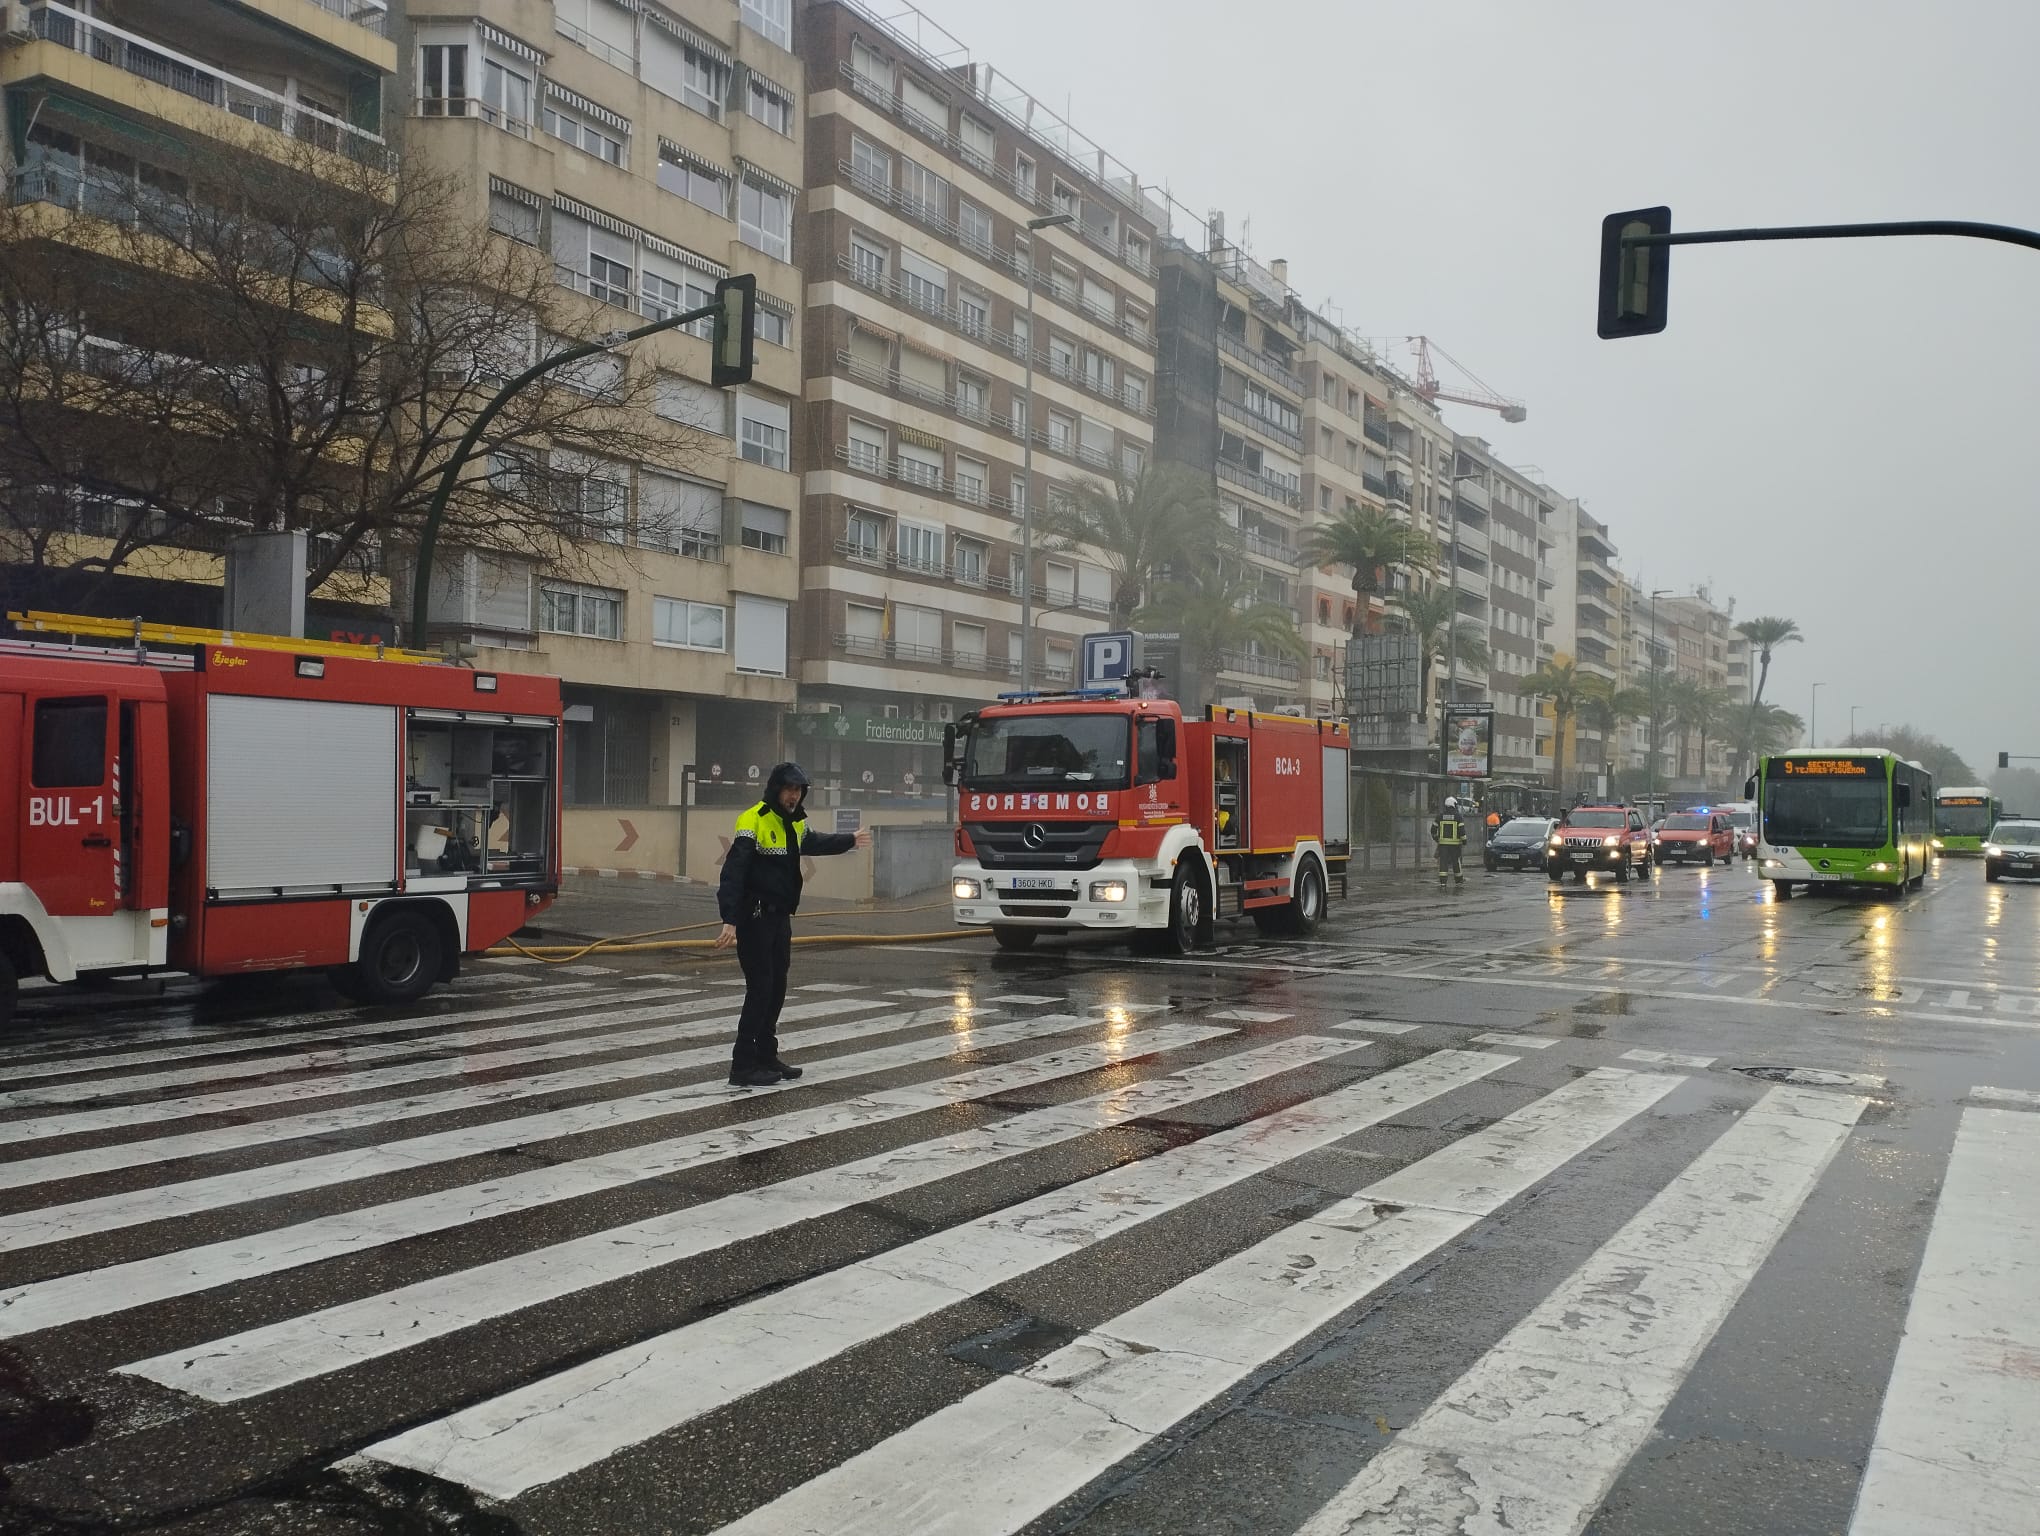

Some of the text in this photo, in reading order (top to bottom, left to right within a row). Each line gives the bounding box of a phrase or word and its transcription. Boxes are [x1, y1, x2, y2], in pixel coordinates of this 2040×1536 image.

[1094, 641, 1121, 679] P
[866, 719, 924, 741] Fraternidad
[1785, 761, 1793, 774] 9
[29, 795, 103, 826] BUL-1
[1018, 880, 1053, 888] 3602 HKD
